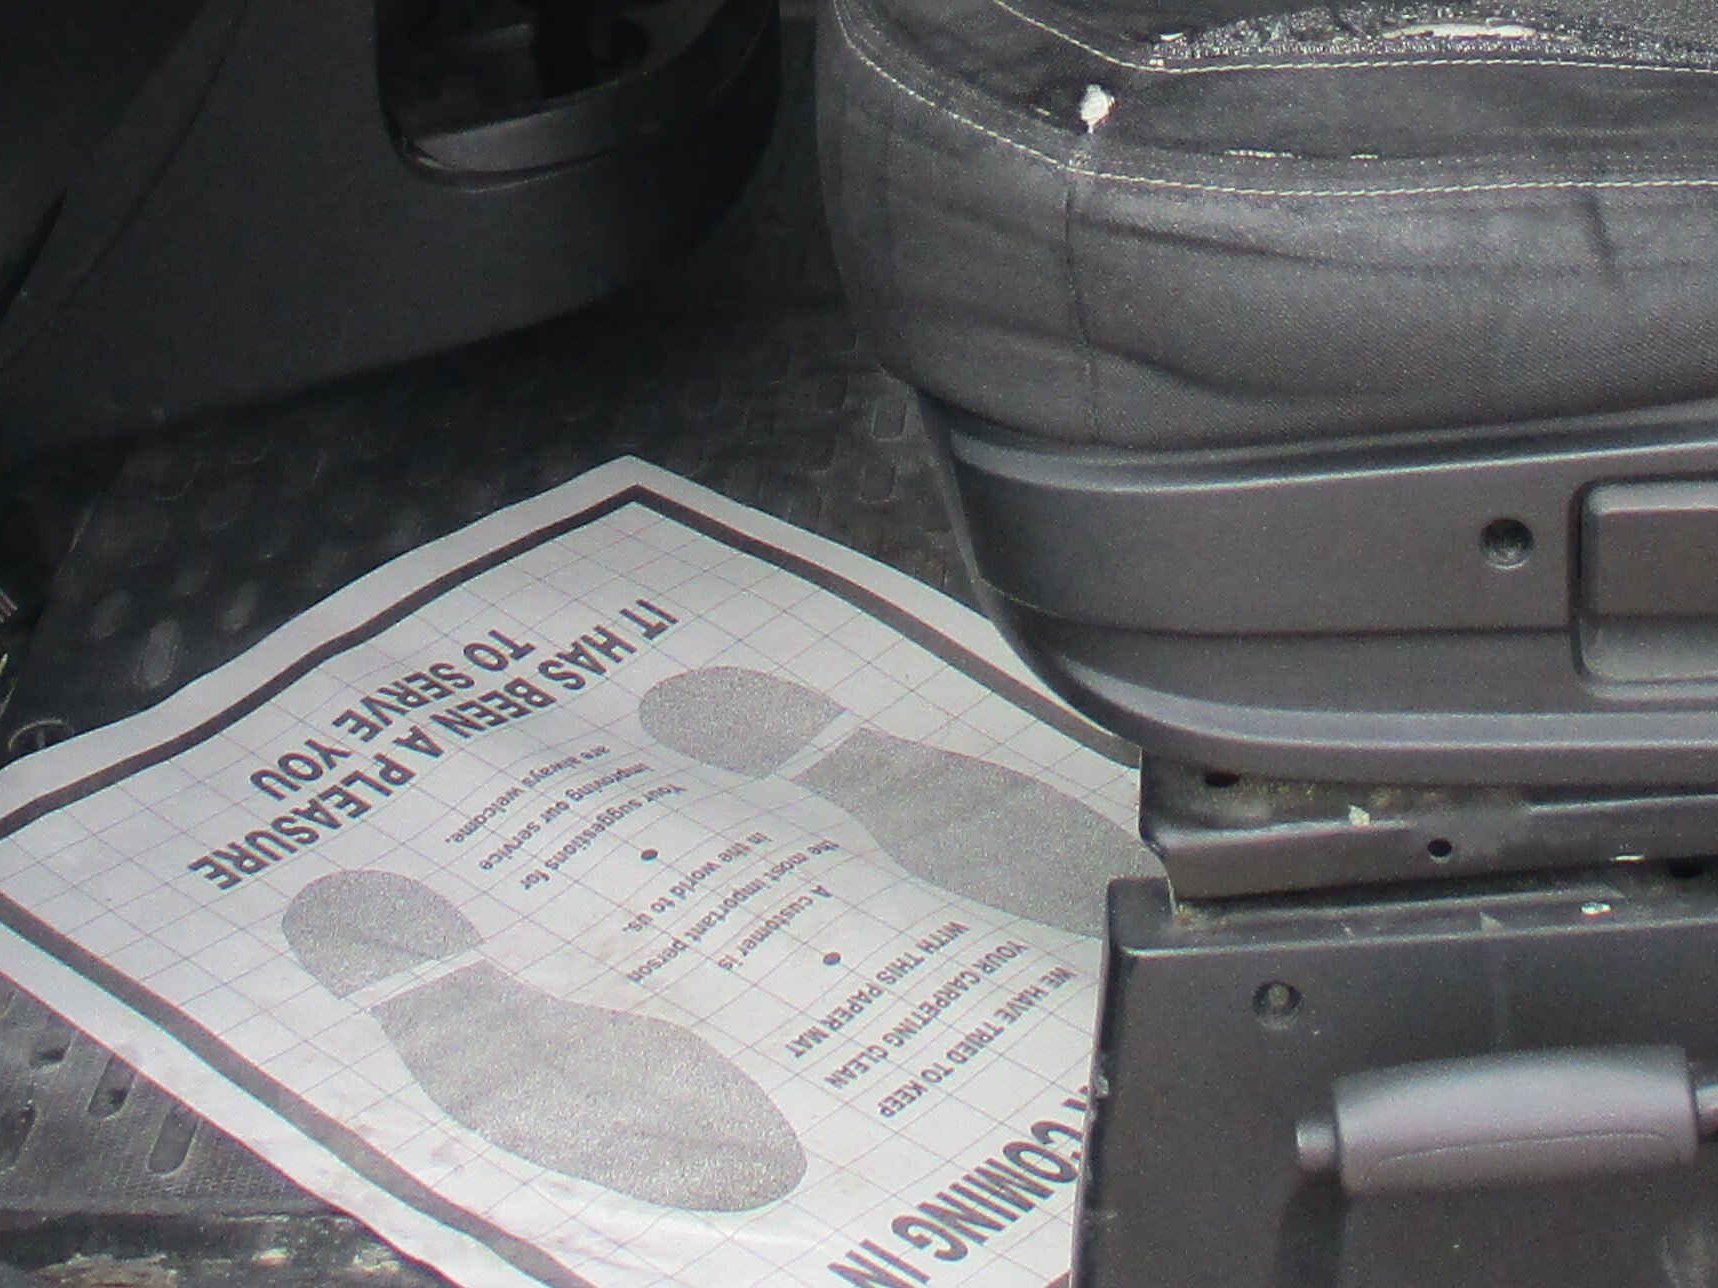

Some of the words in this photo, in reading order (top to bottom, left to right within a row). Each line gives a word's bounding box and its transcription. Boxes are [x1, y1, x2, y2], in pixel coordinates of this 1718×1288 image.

[619, 598, 680, 641] IT
[462, 629, 538, 672] TO
[537, 624, 638, 691] HAS
[331, 662, 476, 743] SERVE
[430, 676, 558, 739] BEEN
[393, 724, 445, 759] A
[580, 744, 612, 762] are
[249, 739, 353, 802] YOU
[520, 755, 583, 790] always
[564, 761, 653, 802] improving
[539, 799, 572, 825] our
[642, 783, 688, 804] Your
[187, 752, 418, 891] PLEASURE
[445, 786, 526, 845] welcome.
[545, 797, 644, 870] suggestions
[478, 820, 542, 872] service
[717, 841, 752, 865] the
[747, 831, 774, 846] in
[805, 838, 843, 856] the
[519, 866, 552, 891] for
[668, 861, 721, 902] world
[761, 851, 810, 883] most
[649, 894, 677, 916] to
[683, 876, 772, 944] important
[809, 883, 835, 899] A
[621, 911, 655, 934] us.
[736, 893, 816, 958] customer
[913, 919, 970, 957] WITH
[625, 937, 688, 985] person
[716, 950, 745, 972] is
[874, 950, 926, 987] THIS
[971, 938, 1030, 977] YOUR
[1039, 965, 1079, 992] WE
[818, 981, 886, 1033] PAPER
[880, 967, 983, 1050] CARPETING
[992, 983, 1051, 1025] HAVE
[784, 1024, 831, 1060] MAT
[945, 1018, 1006, 1067] TRIED
[823, 1042, 891, 1091] CLEAN
[919, 1060, 957, 1086] TO
[877, 1079, 931, 1120] KEEP
[891, 1120, 1084, 1262] COMING
[826, 1238, 932, 1288] IN
